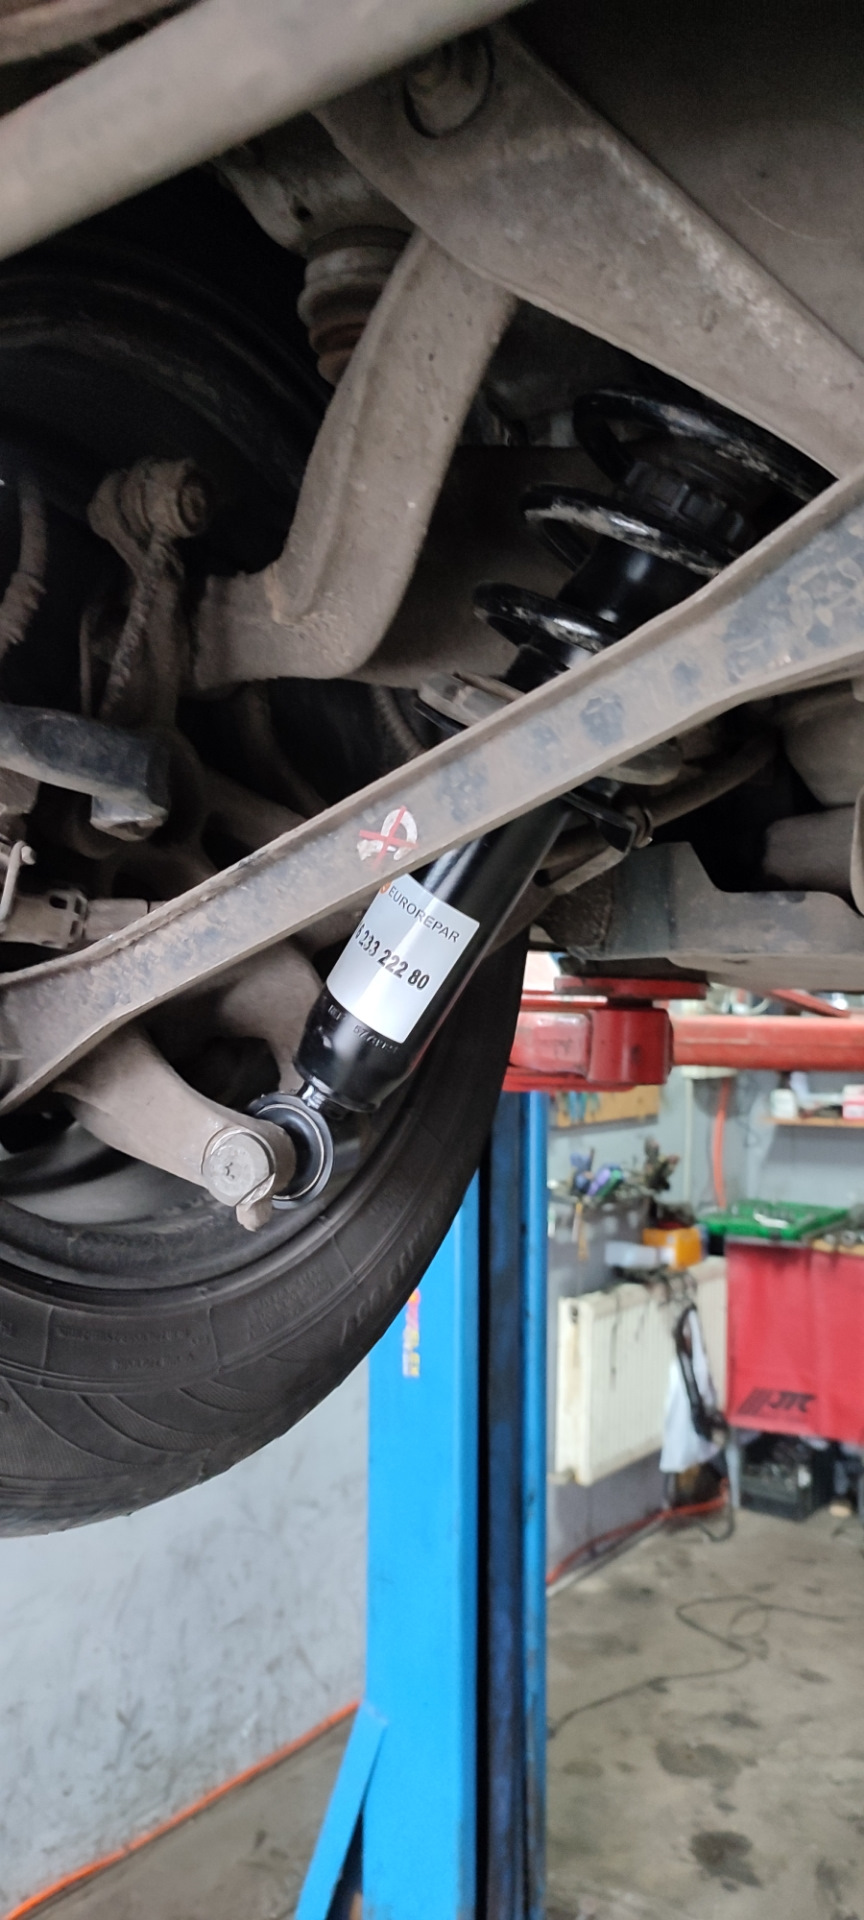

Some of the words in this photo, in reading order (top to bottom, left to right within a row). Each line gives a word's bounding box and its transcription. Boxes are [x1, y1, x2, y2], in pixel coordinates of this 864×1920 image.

[388, 885, 460, 943] EUROREPAR
[358, 929, 381, 957] 233
[377, 949, 409, 979] 222
[407, 969, 431, 991] 80
